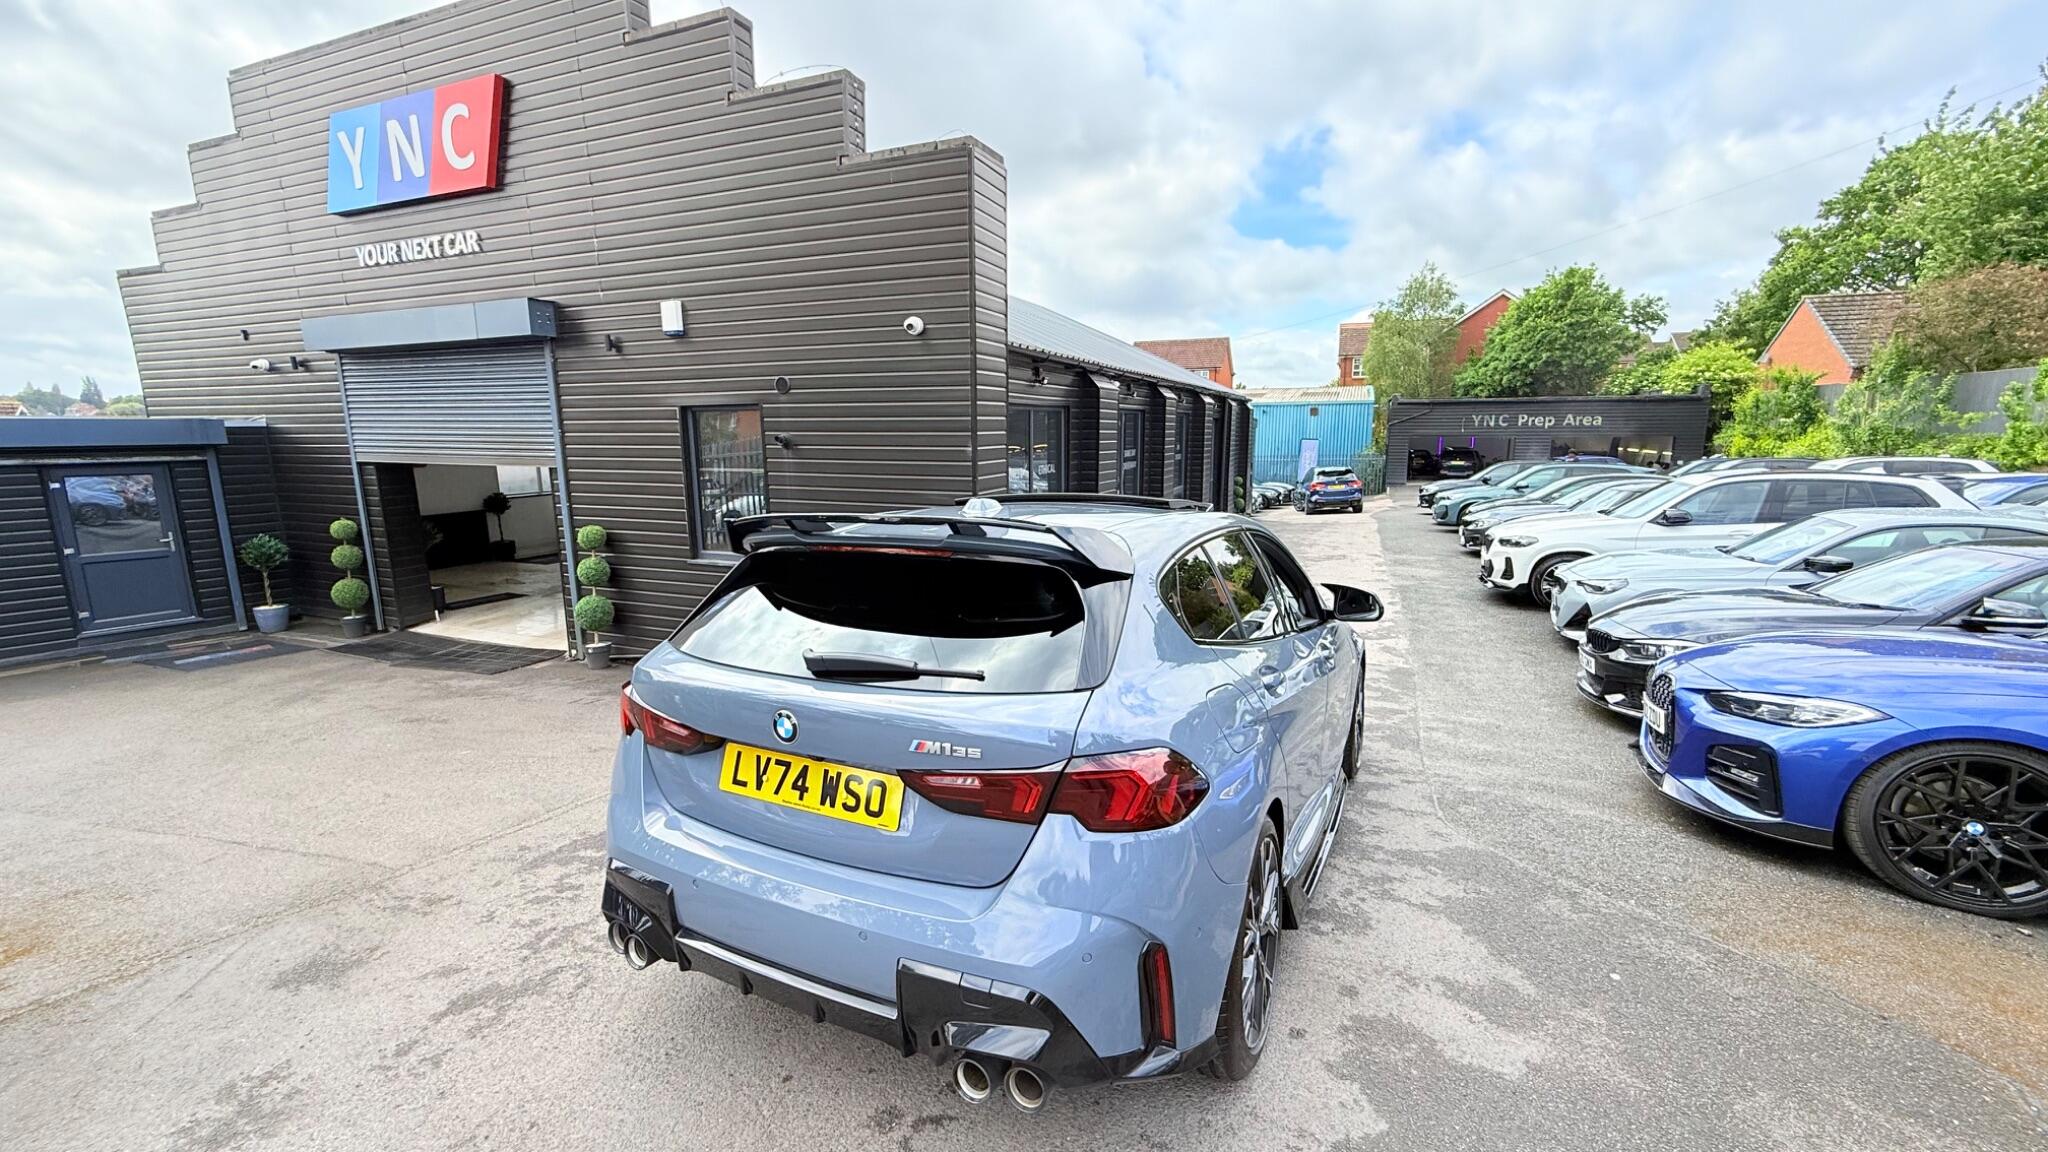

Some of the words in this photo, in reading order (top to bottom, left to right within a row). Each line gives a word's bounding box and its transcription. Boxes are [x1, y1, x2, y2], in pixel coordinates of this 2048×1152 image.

[336, 103, 476, 189] YNC
[354, 241, 399, 267] YOUR
[400, 234, 442, 262] NEXT
[443, 229, 482, 254] CAR
[1471, 414, 1510, 428] YNC
[1517, 414, 1555, 430] Prep
[1562, 413, 1603, 427] Area
[924, 740, 982, 759] M135
[731, 750, 810, 802] LV74
[819, 768, 888, 819] WSO
